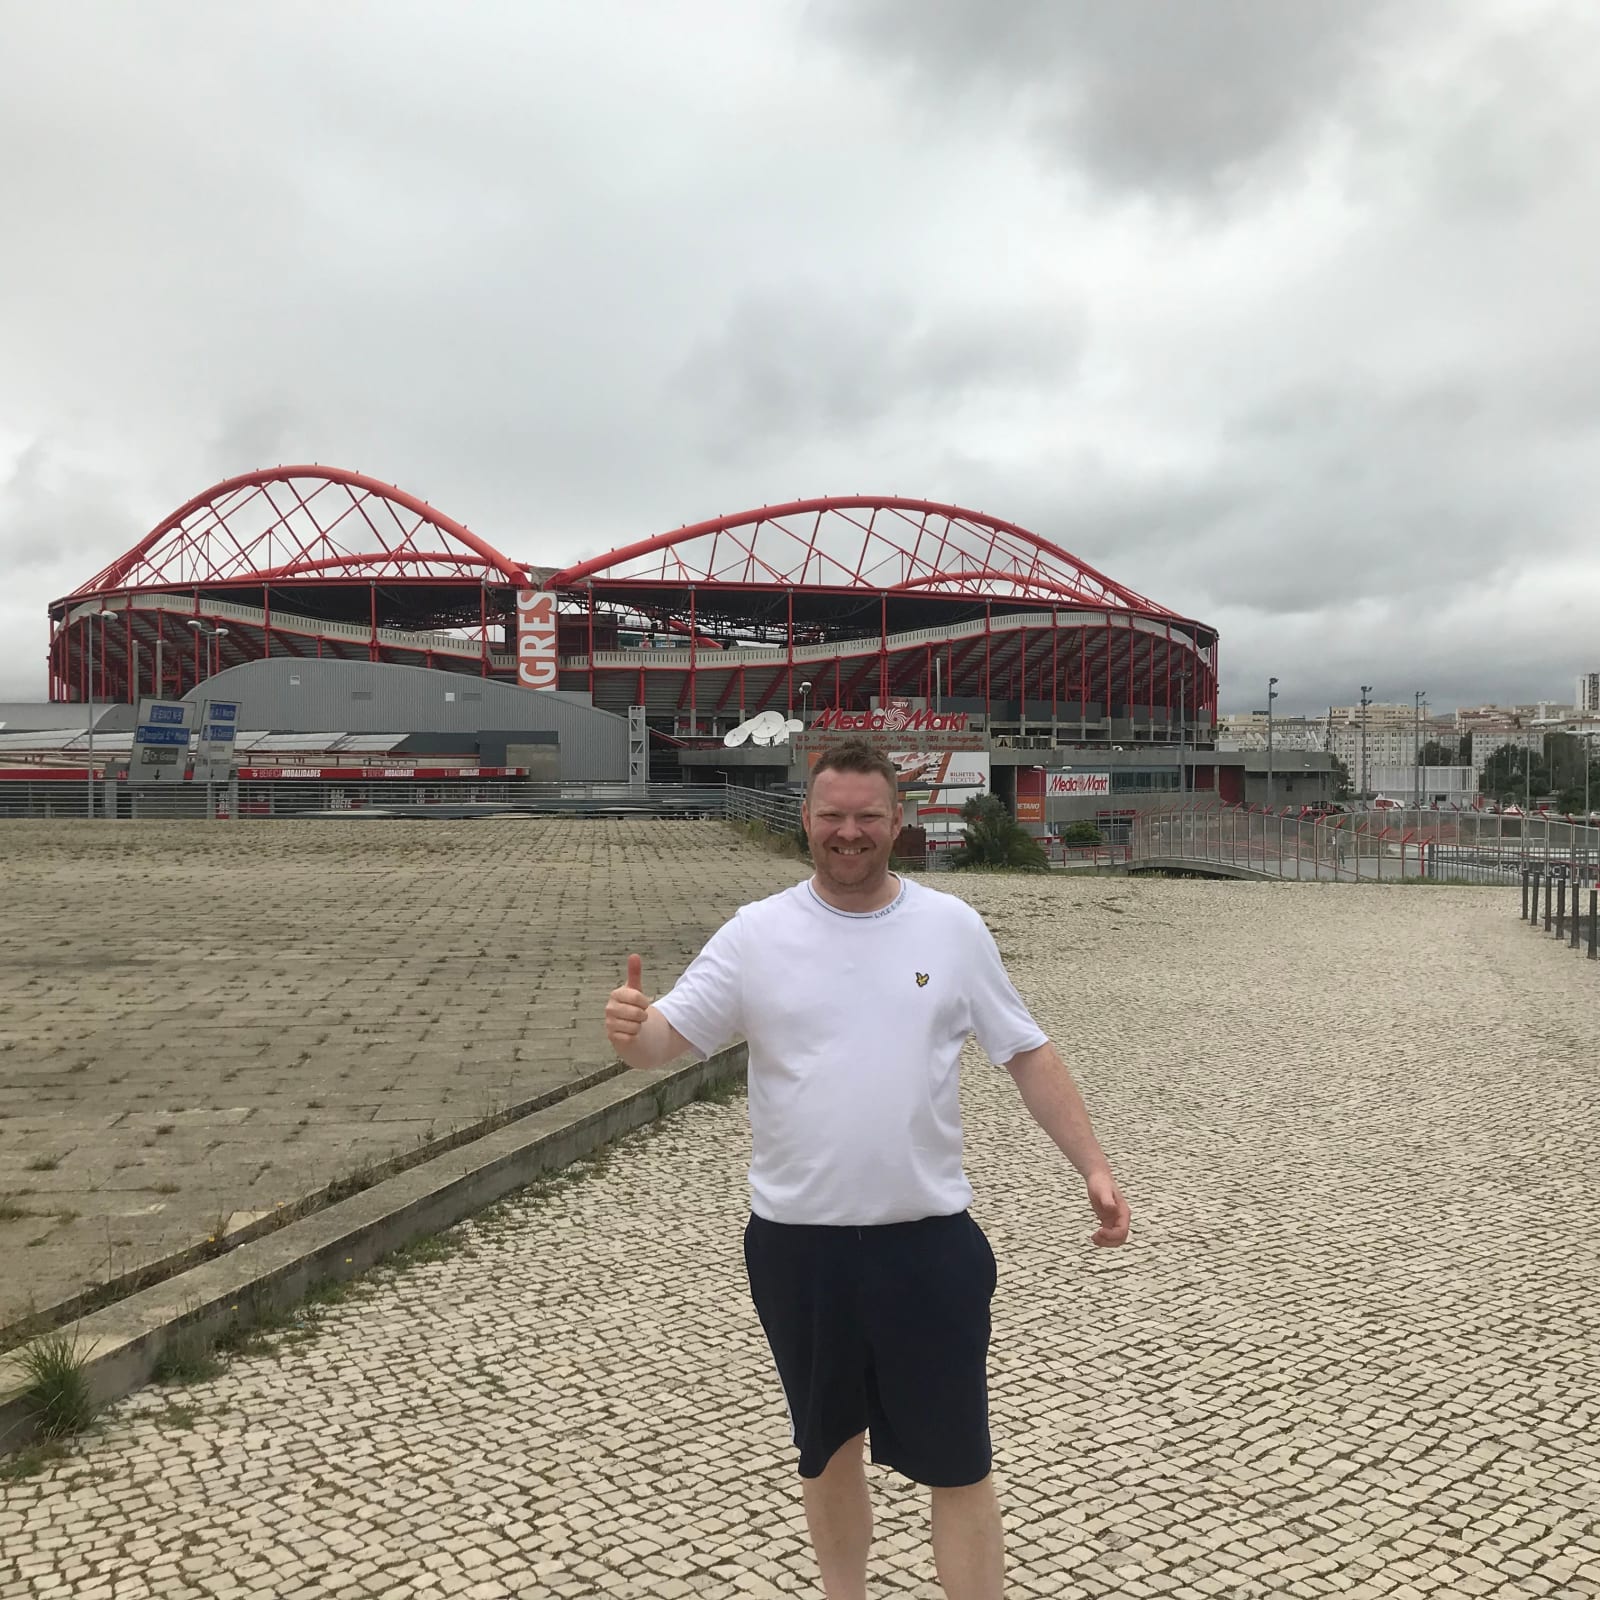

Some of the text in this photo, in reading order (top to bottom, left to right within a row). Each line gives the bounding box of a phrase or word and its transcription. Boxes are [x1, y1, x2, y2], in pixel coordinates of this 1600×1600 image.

[810, 707, 969, 732] Media Markt
[1049, 774, 1108, 792] Media Markt
